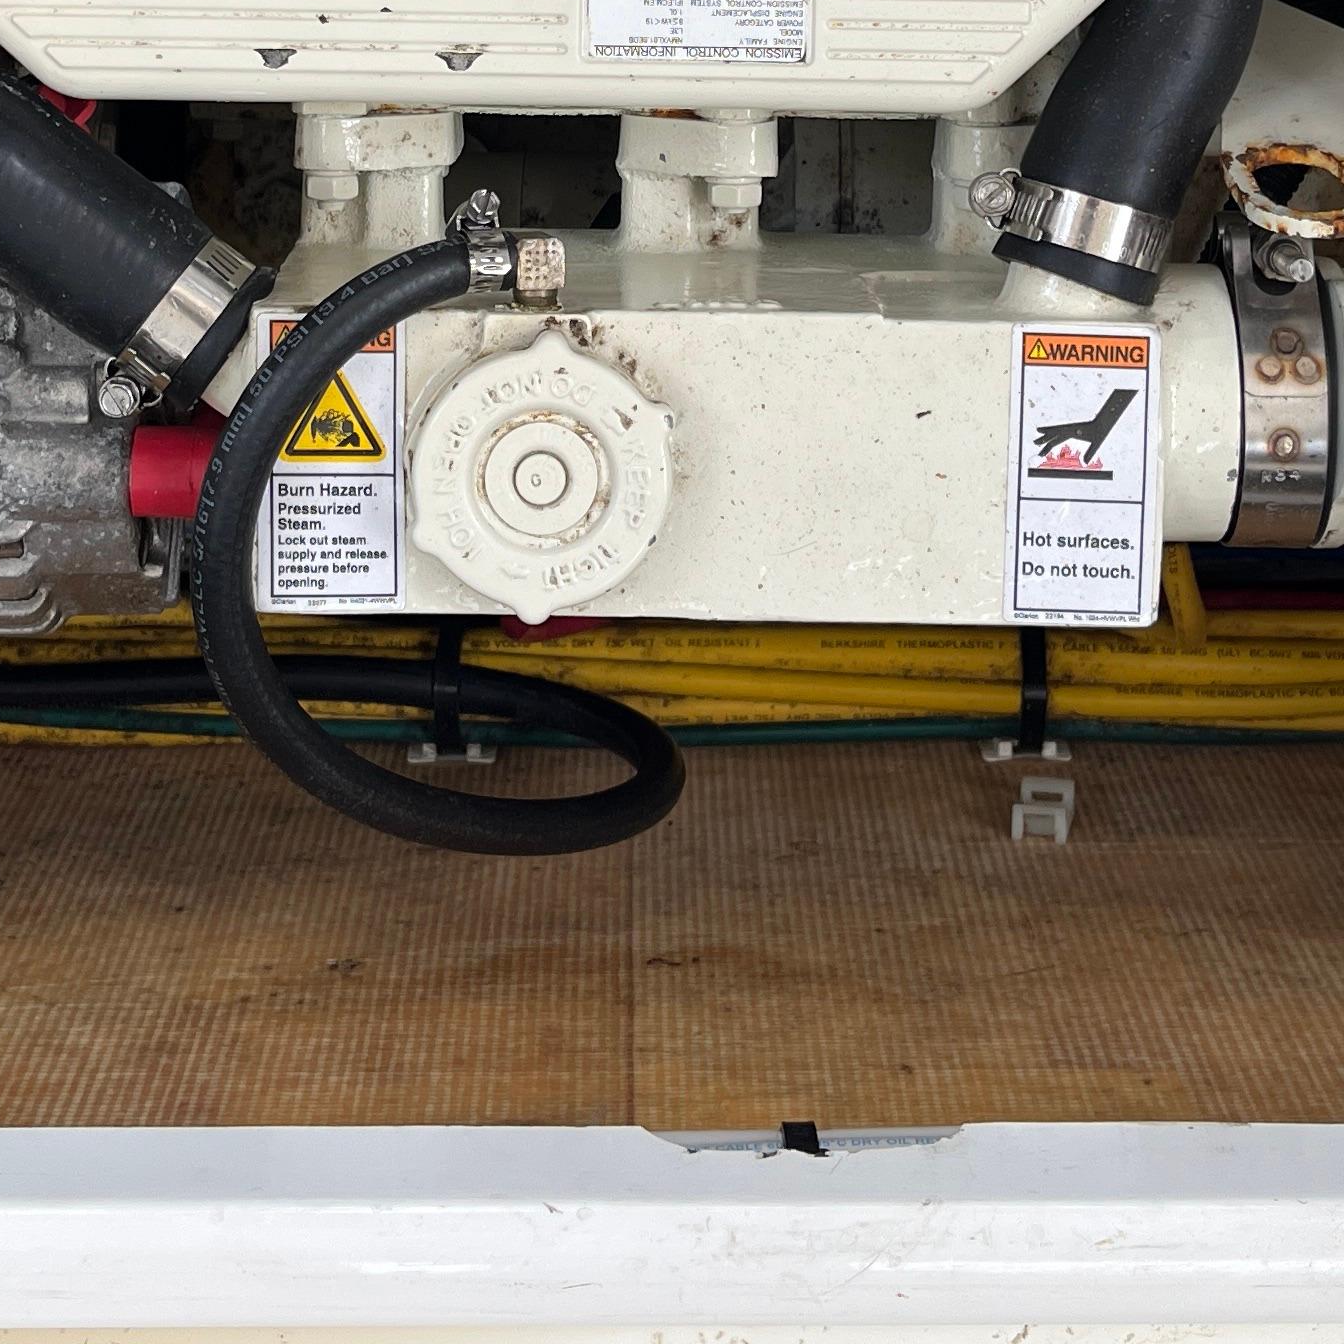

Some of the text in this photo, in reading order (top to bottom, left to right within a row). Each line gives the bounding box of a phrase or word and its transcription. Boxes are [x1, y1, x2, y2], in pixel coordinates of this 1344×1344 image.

[596, 47, 803, 58] EMISSION CONTROL INFORMATION
[1049, 344, 1144, 363] WARNING
[278, 483, 377, 496] Burn Hazard.
[278, 503, 360, 514] Pressurized
[278, 518, 325, 530] Steam.
[278, 535, 366, 545] Lock out steam
[1023, 531, 1134, 550] Hot surfaces.
[278, 549, 316, 561] supply
[320, 549, 341, 559] and
[278, 563, 369, 574] pressure before
[1022, 562, 1134, 579] Do not touch.
[278, 577, 327, 589] opening.
